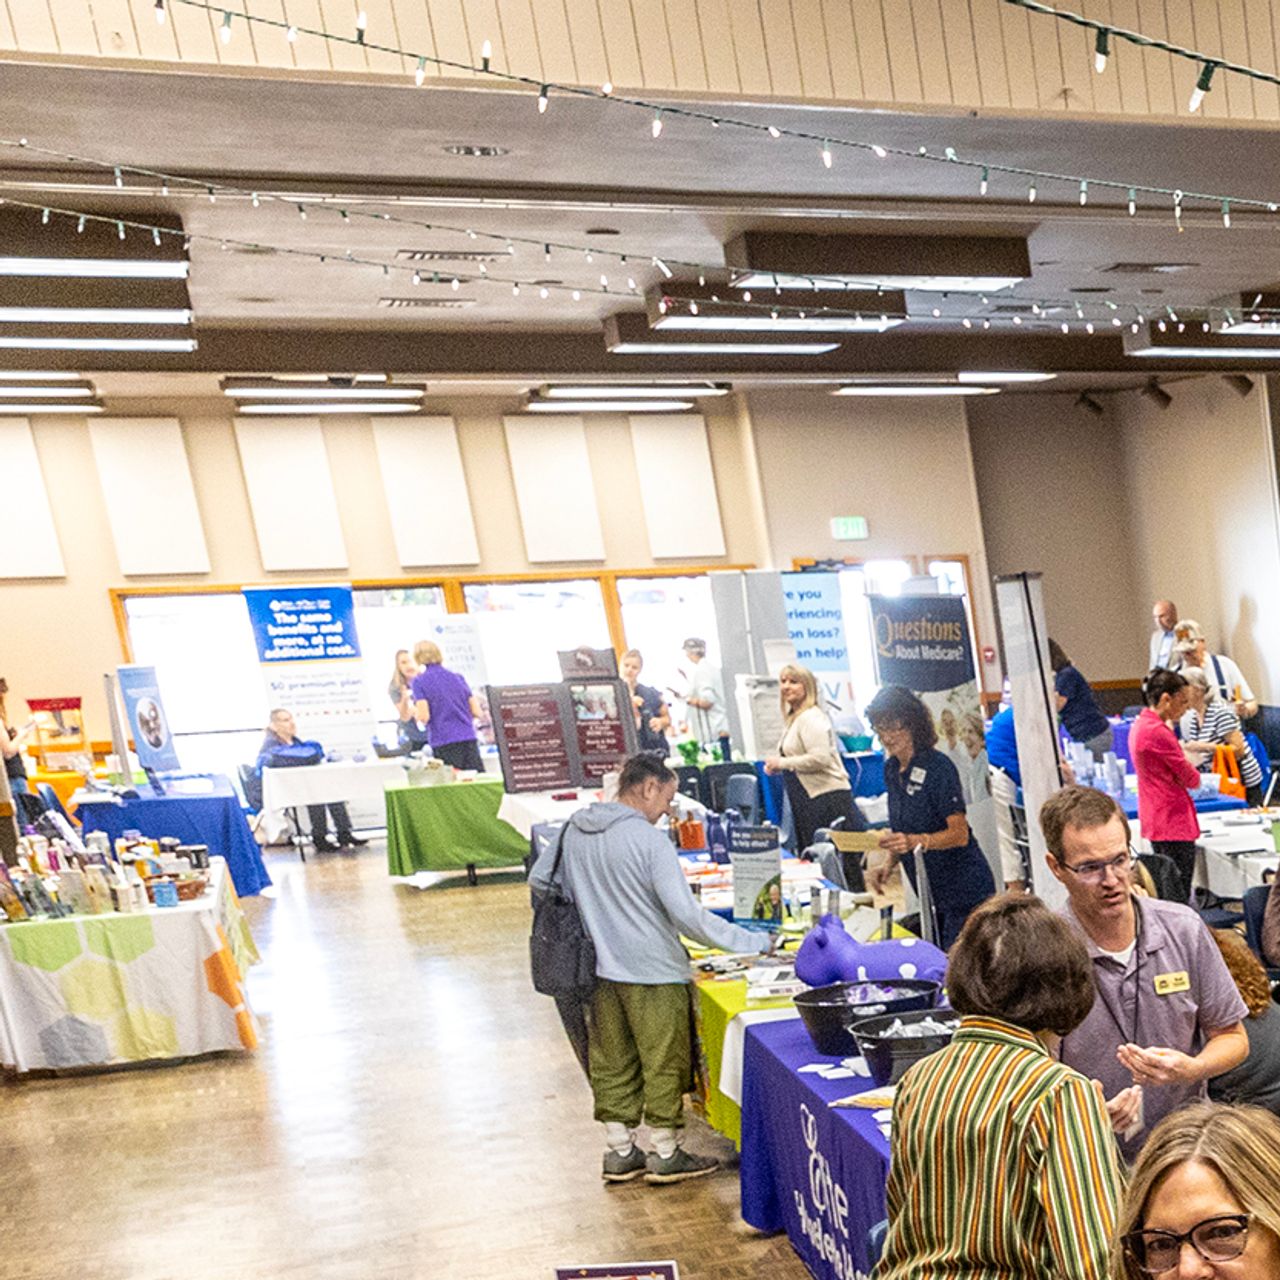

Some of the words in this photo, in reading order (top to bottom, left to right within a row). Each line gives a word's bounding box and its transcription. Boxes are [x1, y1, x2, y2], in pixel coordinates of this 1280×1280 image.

[797, 590, 822, 602] you
[273, 612, 298, 624] The
[299, 613, 332, 623] same
[267, 622, 318, 636] benefits
[320, 620, 343, 633] and
[808, 627, 840, 639] loss?
[325, 635, 343, 645] no
[876, 613, 962, 657] Questions
[264, 644, 325, 659] additional
[896, 644, 920, 660] About
[921, 644, 964, 661] Medicare?
